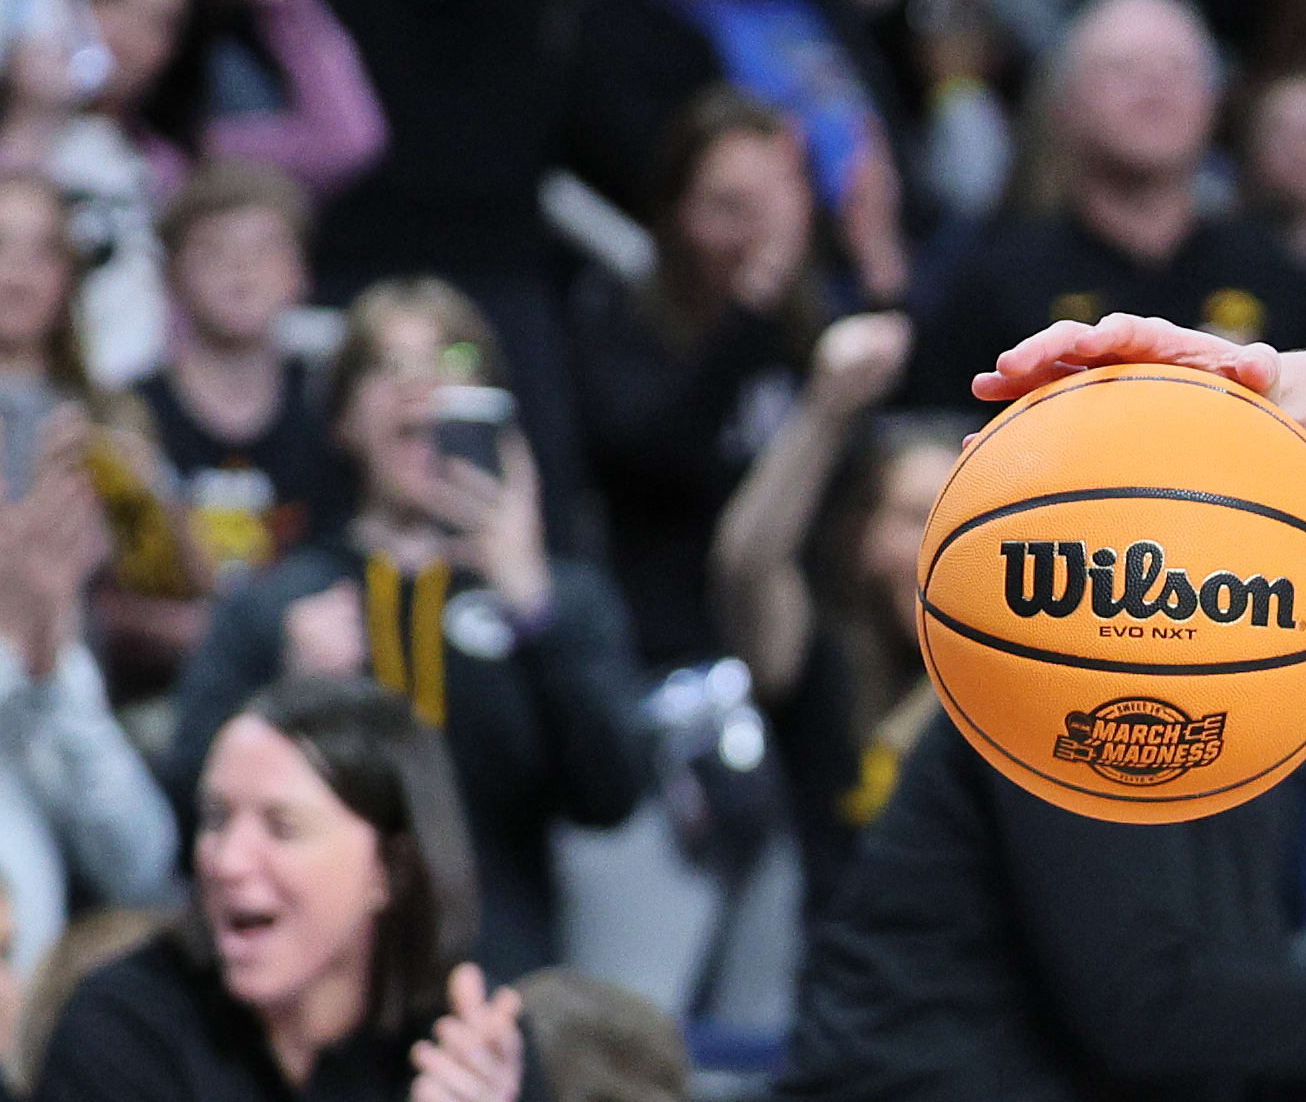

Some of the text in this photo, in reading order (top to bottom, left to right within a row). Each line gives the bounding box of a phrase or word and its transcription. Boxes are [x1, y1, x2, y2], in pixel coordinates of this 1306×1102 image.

[1000, 539, 1297, 629] Wilson
[1100, 626, 1198, 640] EVO NXT
[1092, 719, 1182, 745] MARCH
[1101, 739, 1222, 765] MADNESS
